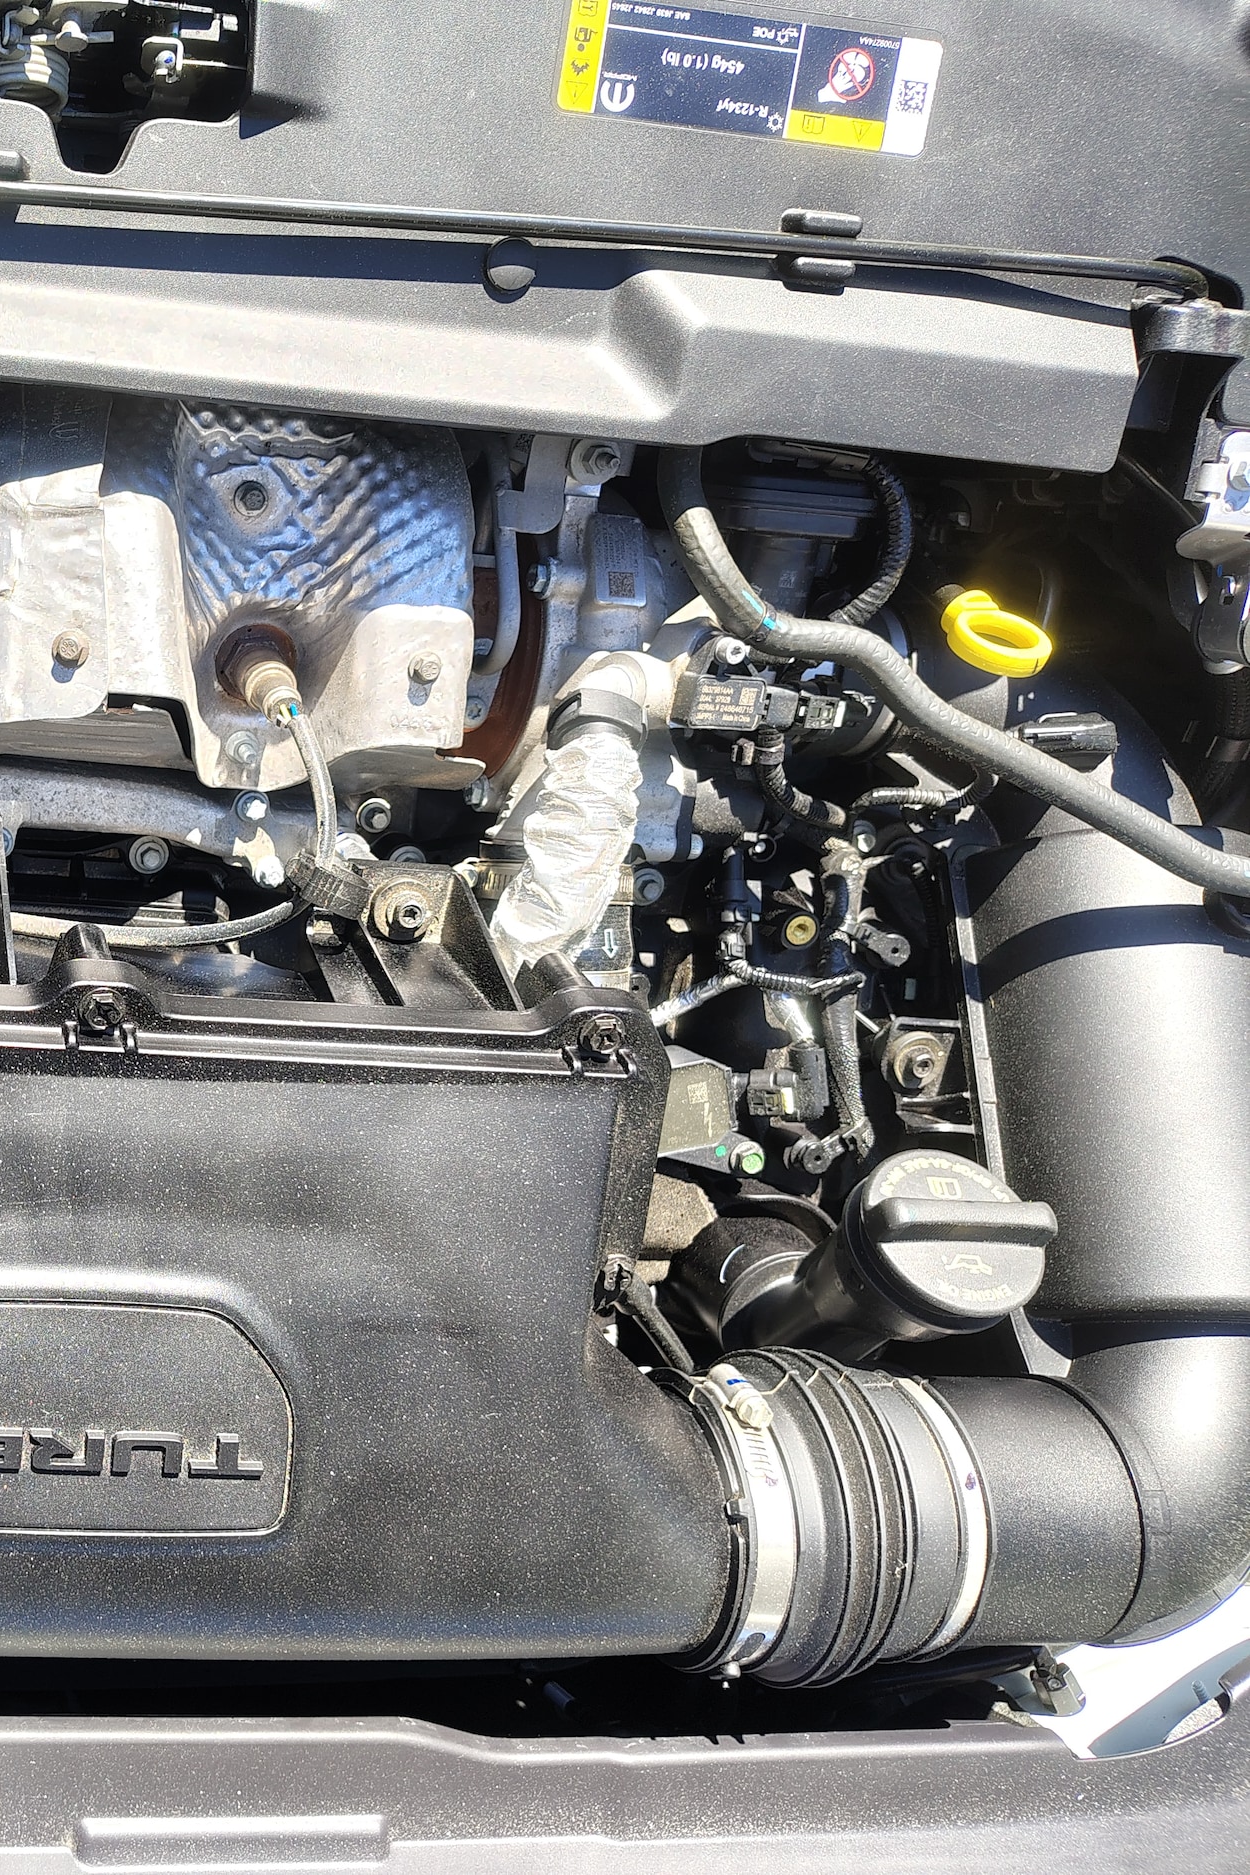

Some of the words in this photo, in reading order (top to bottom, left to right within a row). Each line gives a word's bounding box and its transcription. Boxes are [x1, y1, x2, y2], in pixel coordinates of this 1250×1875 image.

[675, 11, 690, 20] SAE
[752, 26, 775, 39] POE
[661, 48, 681, 67] lb)
[683, 53, 709, 70] (1.0
[711, 54, 745, 74] 454g
[716, 97, 768, 117] R-1234yf
[962, 1284, 1014, 1302] ENGINE
